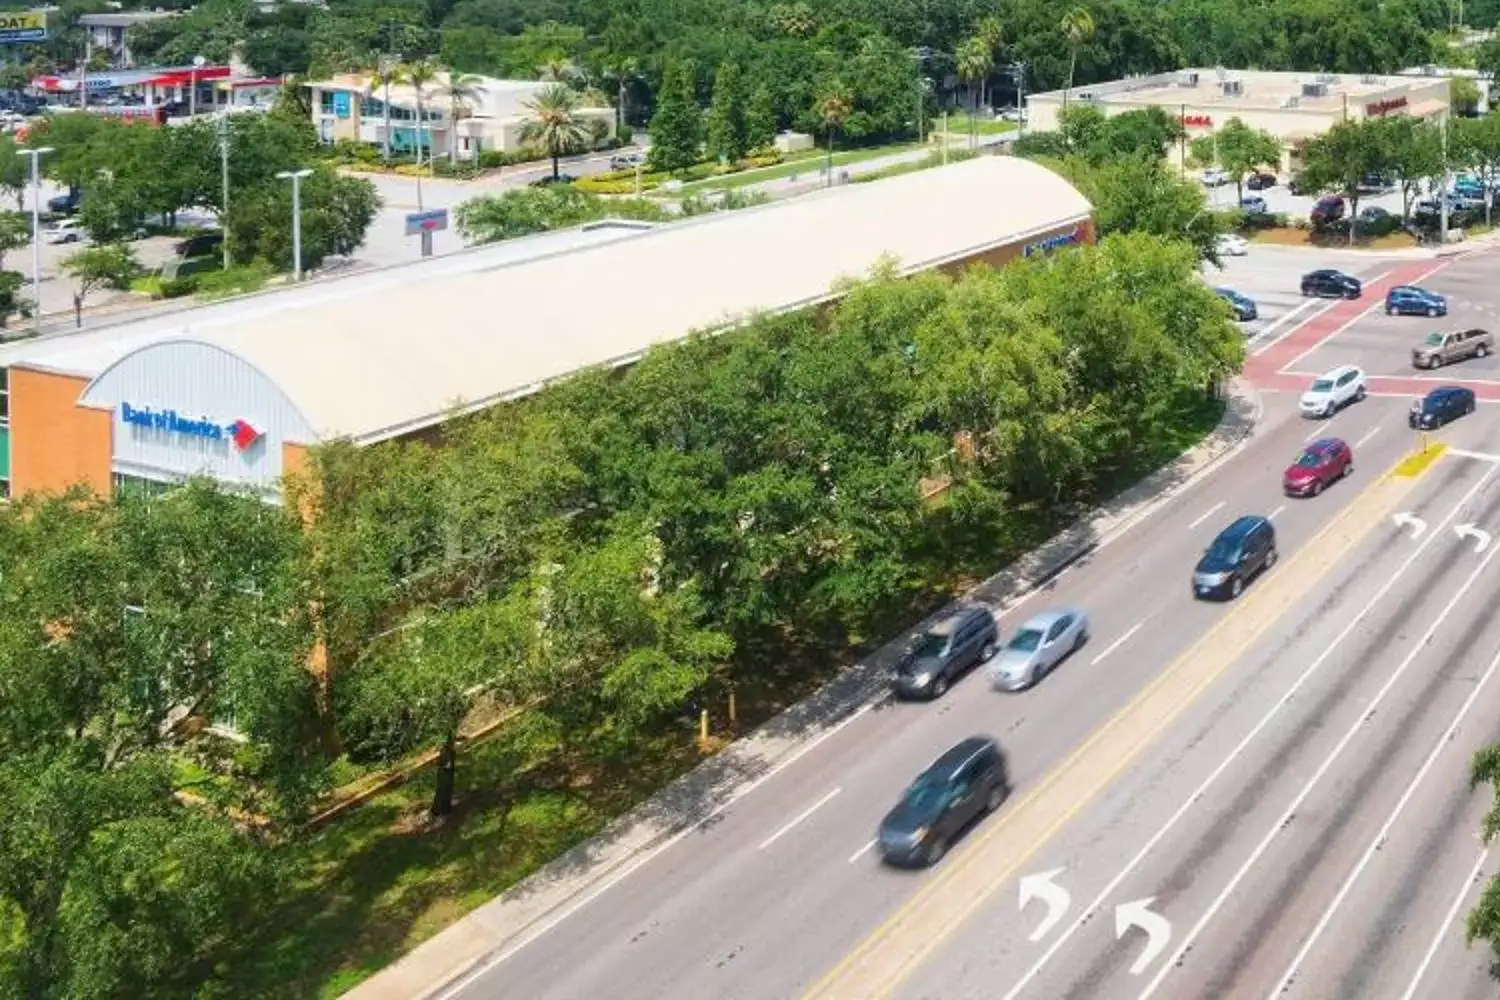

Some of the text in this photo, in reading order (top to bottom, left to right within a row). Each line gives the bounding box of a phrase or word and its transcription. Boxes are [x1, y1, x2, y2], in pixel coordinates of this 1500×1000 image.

[122, 401, 222, 440] Bank of America
